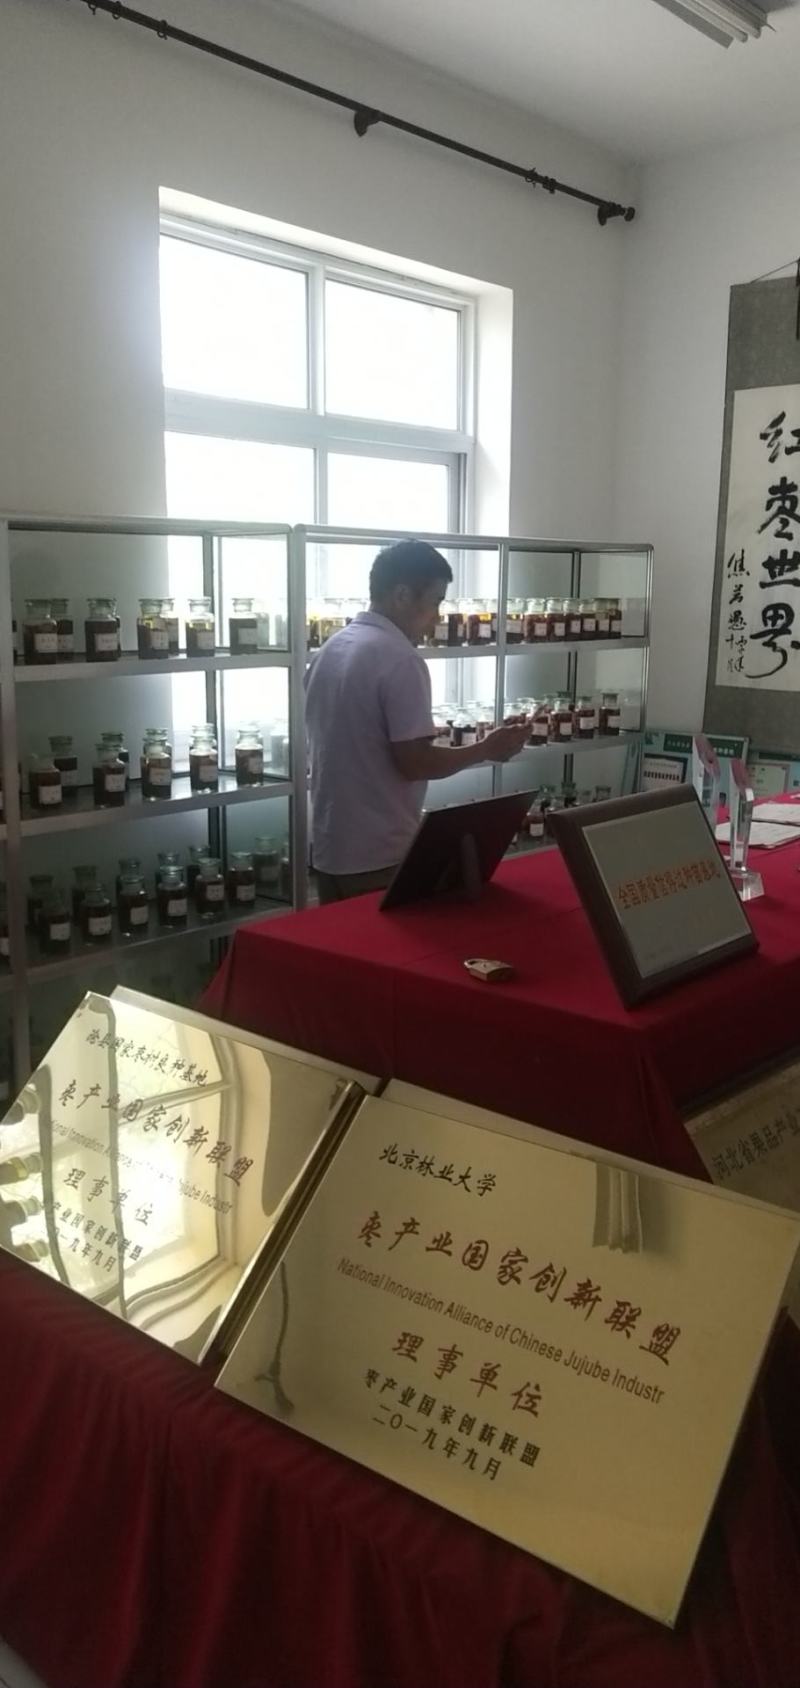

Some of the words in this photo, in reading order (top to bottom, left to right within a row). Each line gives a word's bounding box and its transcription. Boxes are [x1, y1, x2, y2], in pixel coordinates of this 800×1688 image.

[58, 1079, 255, 1188] 枣产业国家创新联盟
[378, 1143, 497, 1197] 北京林业大学
[63, 1167, 154, 1226] 理事单位
[337, 1257, 383, 1289] National
[384, 1270, 445, 1315] Innovation
[443, 1300, 493, 1335] Alliance
[495, 1323, 510, 1341] of
[509, 1327, 564, 1364] Chinese
[564, 1349, 611, 1384] Jujube
[611, 1367, 666, 1405] Industr
[357, 1211, 682, 1366] 枣产业国家创新联盟
[362, 1367, 541, 1468] 枣产业国家创新联盟
[391, 1331, 545, 1419] 理事单位
